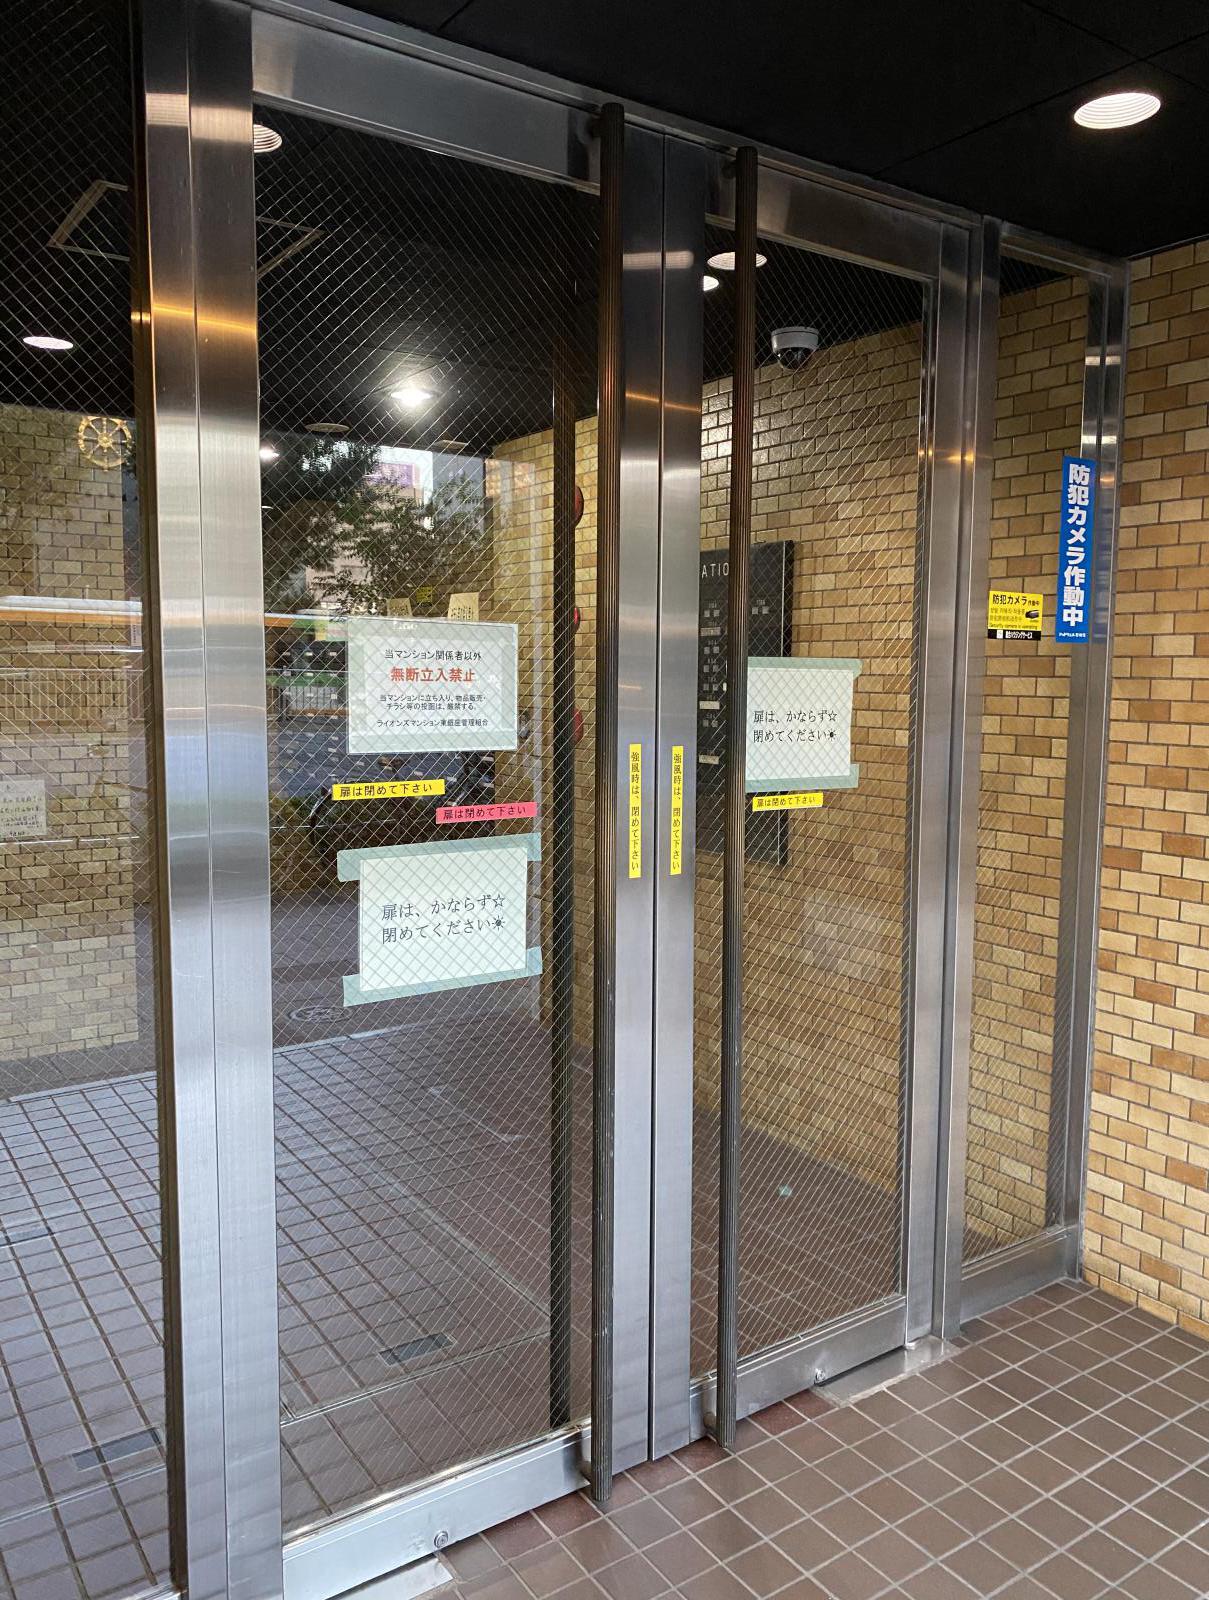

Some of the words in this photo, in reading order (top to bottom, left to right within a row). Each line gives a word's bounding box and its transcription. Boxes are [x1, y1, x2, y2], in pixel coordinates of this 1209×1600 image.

[1062, 463, 1090, 627] 防犯カメラ作動中
[385, 649, 481, 661] 当マンション関係者以外
[389, 666, 475, 682] 無断立入禁止
[340, 783, 433, 798] 扉は閉めて下さい
[756, 796, 816, 808] 扉は閉めて下さい
[443, 806, 526, 820] 扉は閉めて下さい
